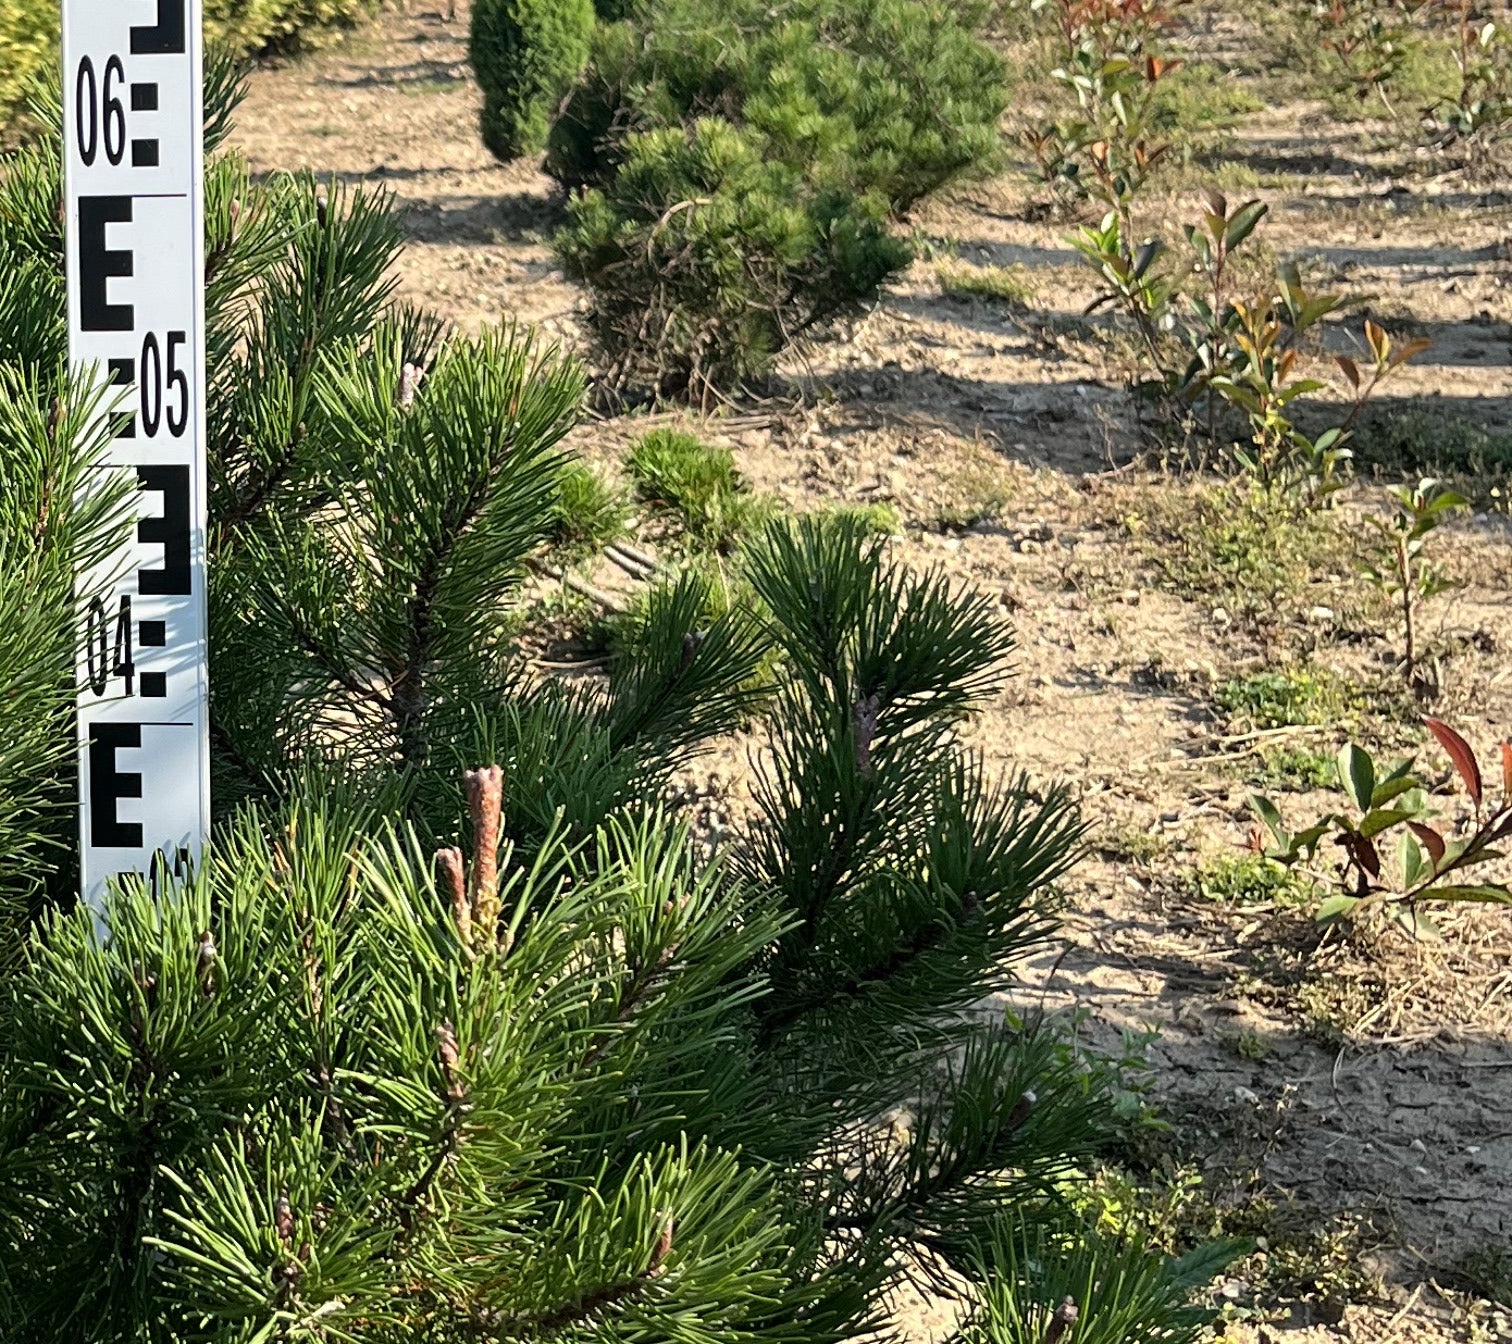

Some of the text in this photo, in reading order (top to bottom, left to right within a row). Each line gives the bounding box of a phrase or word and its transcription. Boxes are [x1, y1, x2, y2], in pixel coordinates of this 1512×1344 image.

[76, 54, 127, 167] 06
[140, 330, 189, 439] 05
[88, 594, 135, 697] 04
